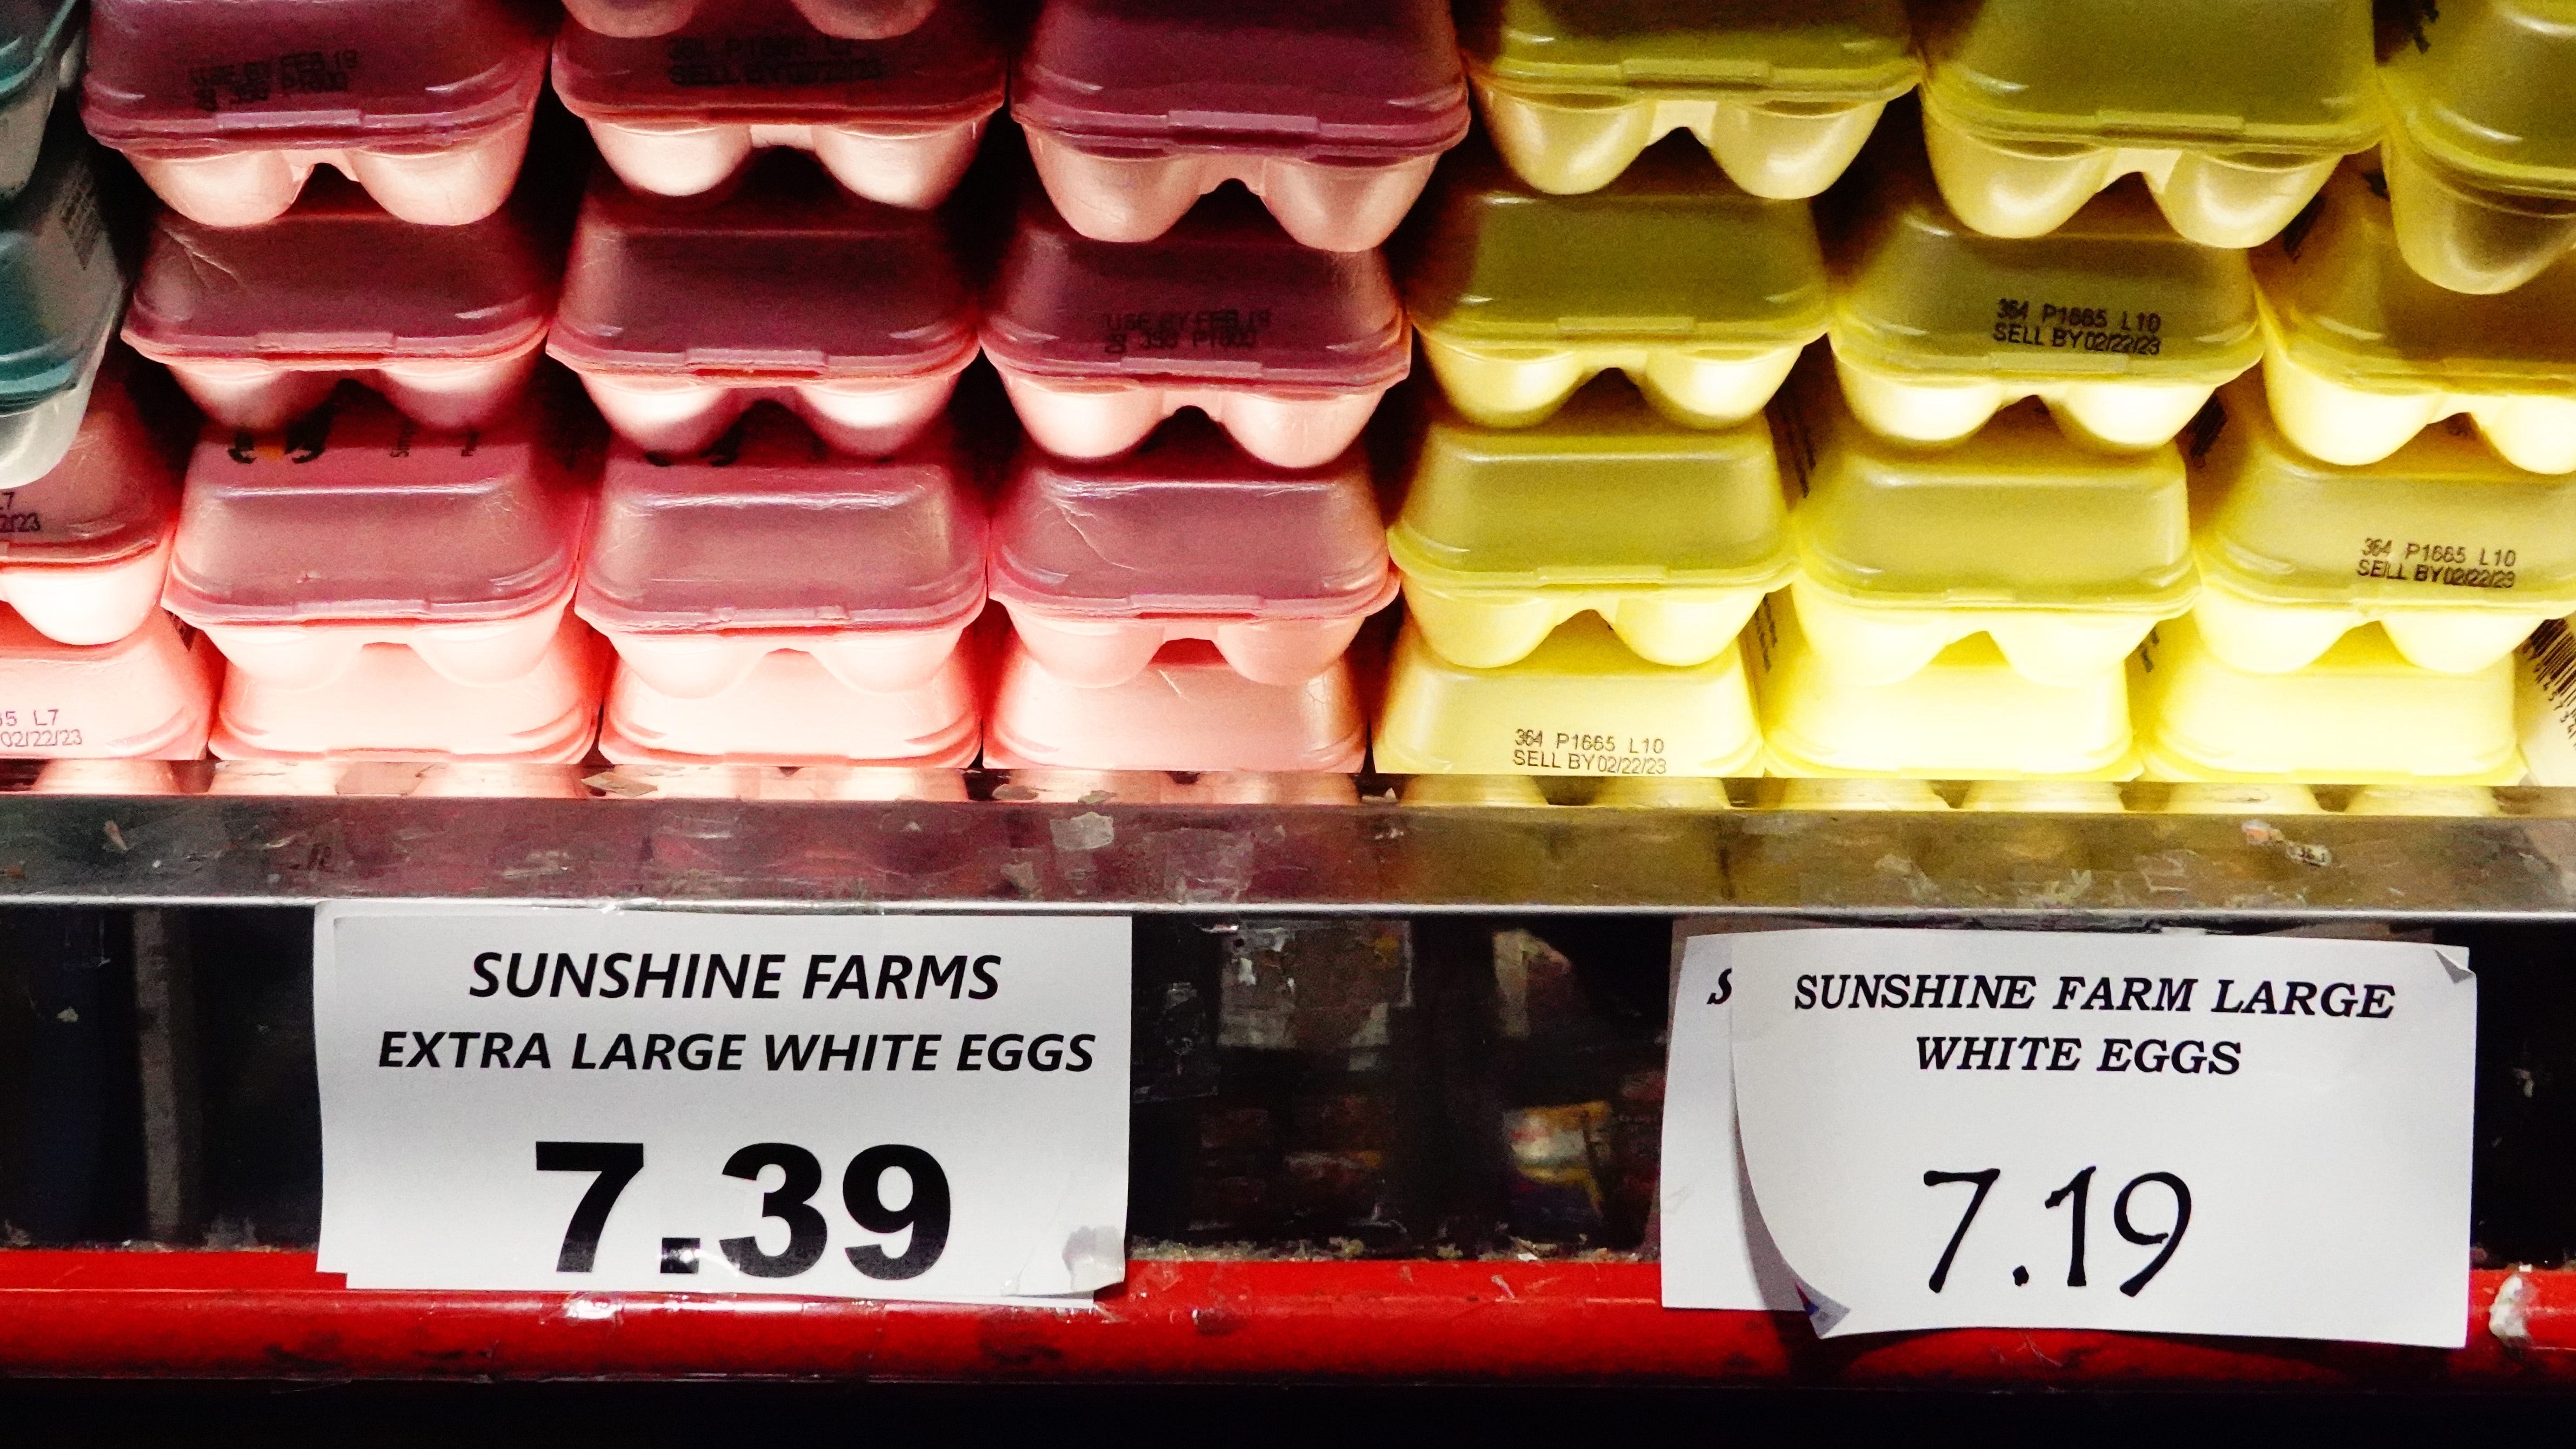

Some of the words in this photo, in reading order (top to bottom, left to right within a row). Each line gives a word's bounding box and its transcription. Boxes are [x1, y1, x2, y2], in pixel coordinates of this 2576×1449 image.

[2120, 311, 2161, 333] L10
[1993, 322, 2045, 346] SELL
[2051, 327, 2084, 349] BY
[2084, 331, 2161, 356] 02/22/23
[2361, 538, 2393, 557] 364
[2405, 542, 2466, 563] P1665
[2479, 547, 2517, 567] L10
[2356, 559, 2407, 580] SELL
[2413, 563, 2444, 583] BY
[2442, 566, 2516, 589] 02/22/23
[33, 709, 59, 726] L7
[0, 729, 82, 747] 02/22/23
[1514, 728, 1544, 747] 364
[1556, 732, 1616, 752] P1665
[1628, 737, 1665, 754] L10
[1512, 749, 1561, 769] SELL
[1567, 752, 1595, 771] BY
[1597, 754, 1667, 774] 02/22/23
[470, 952, 785, 998] SUNSHINE
[803, 955, 1001, 999] FARMS
[1795, 974, 2036, 1009] SUNSHINE
[2053, 977, 2198, 1011] FARM
[2211, 980, 2395, 1018] LARGE
[379, 1031, 550, 1069] EXTRA
[572, 1033, 746, 1070] LARGE
[766, 1034, 942, 1071] WHITE
[957, 1034, 1096, 1072] EGGS
[1917, 1037, 2081, 1070] WHITE
[2097, 1039, 2240, 1074] EGGS
[536, 1141, 950, 1279] 7.39
[1924, 1166, 2191, 1297] 7.19
